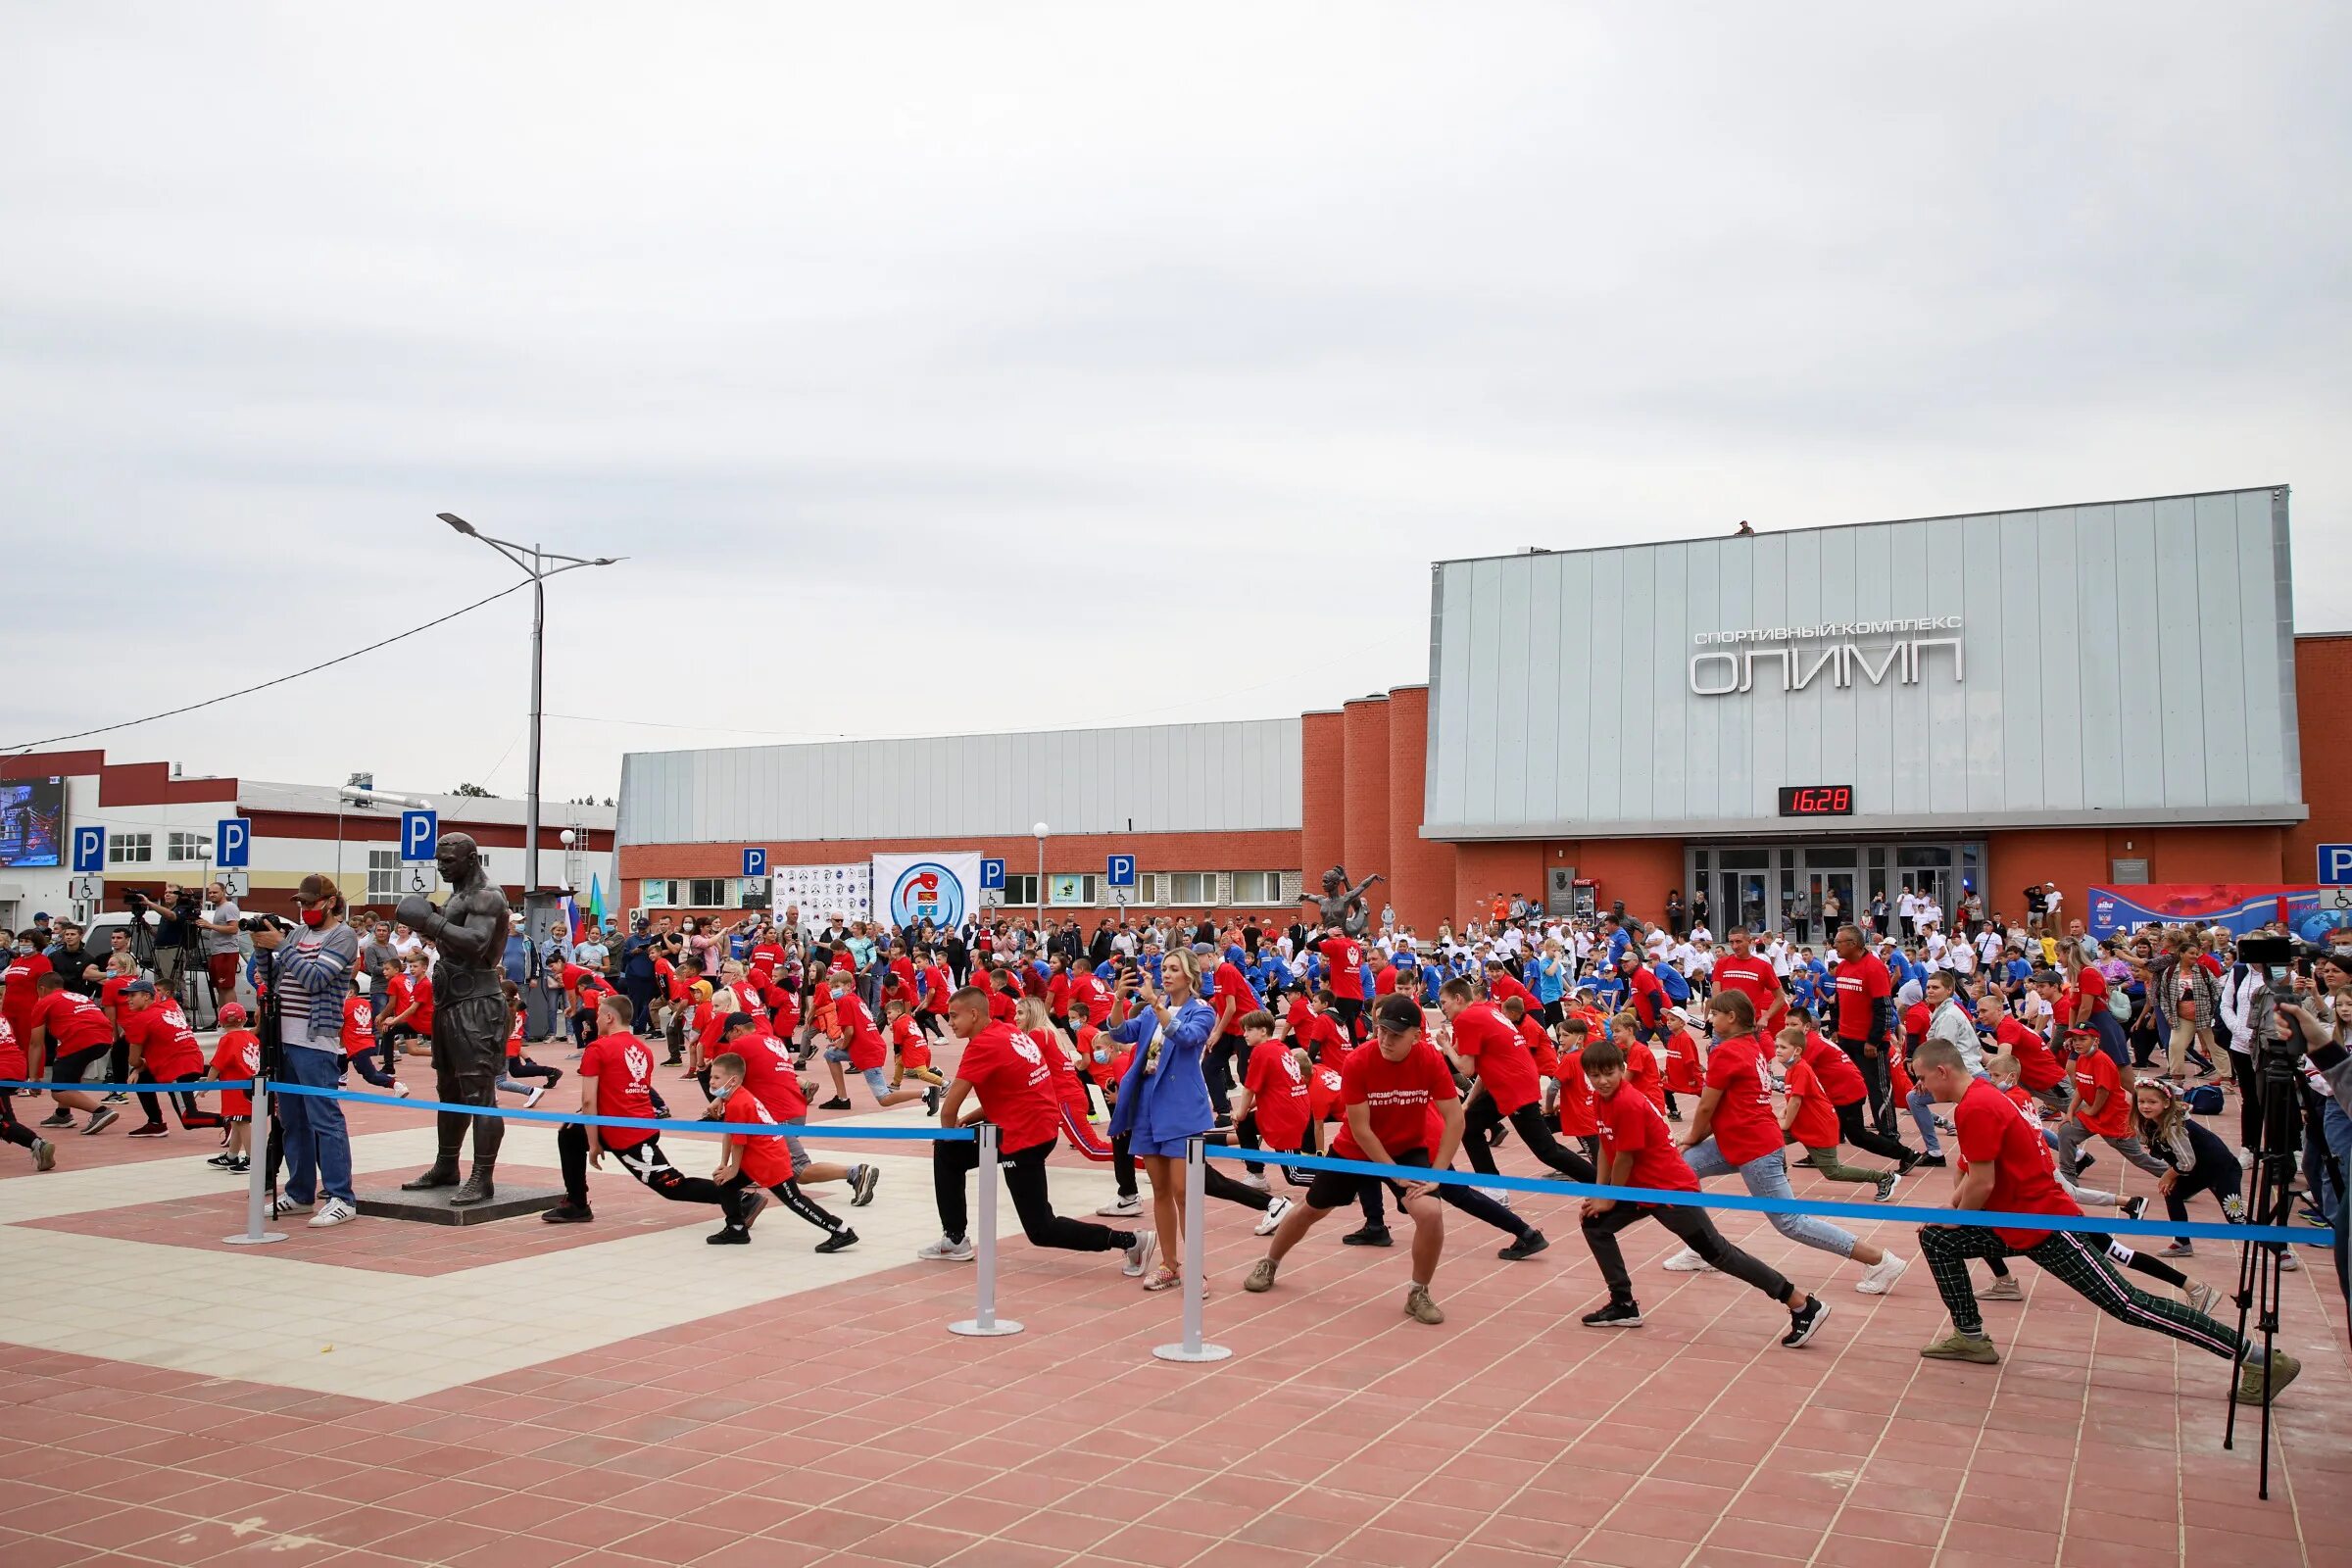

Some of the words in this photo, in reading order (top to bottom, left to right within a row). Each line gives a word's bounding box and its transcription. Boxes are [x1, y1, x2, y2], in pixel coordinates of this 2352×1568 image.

[1694, 621, 1837, 645] СПОРТИВНЫЙ
[1841, 615, 1962, 635] КОМПЛЕКС
[1690, 637, 1963, 695] ОЛИМП
[81, 831, 99, 867] P
[225, 824, 244, 862] P
[410, 815, 431, 856] P
[749, 851, 762, 873] P
[986, 862, 1001, 885] P
[1114, 858, 1129, 882] P
[2331, 849, 2352, 880] P
